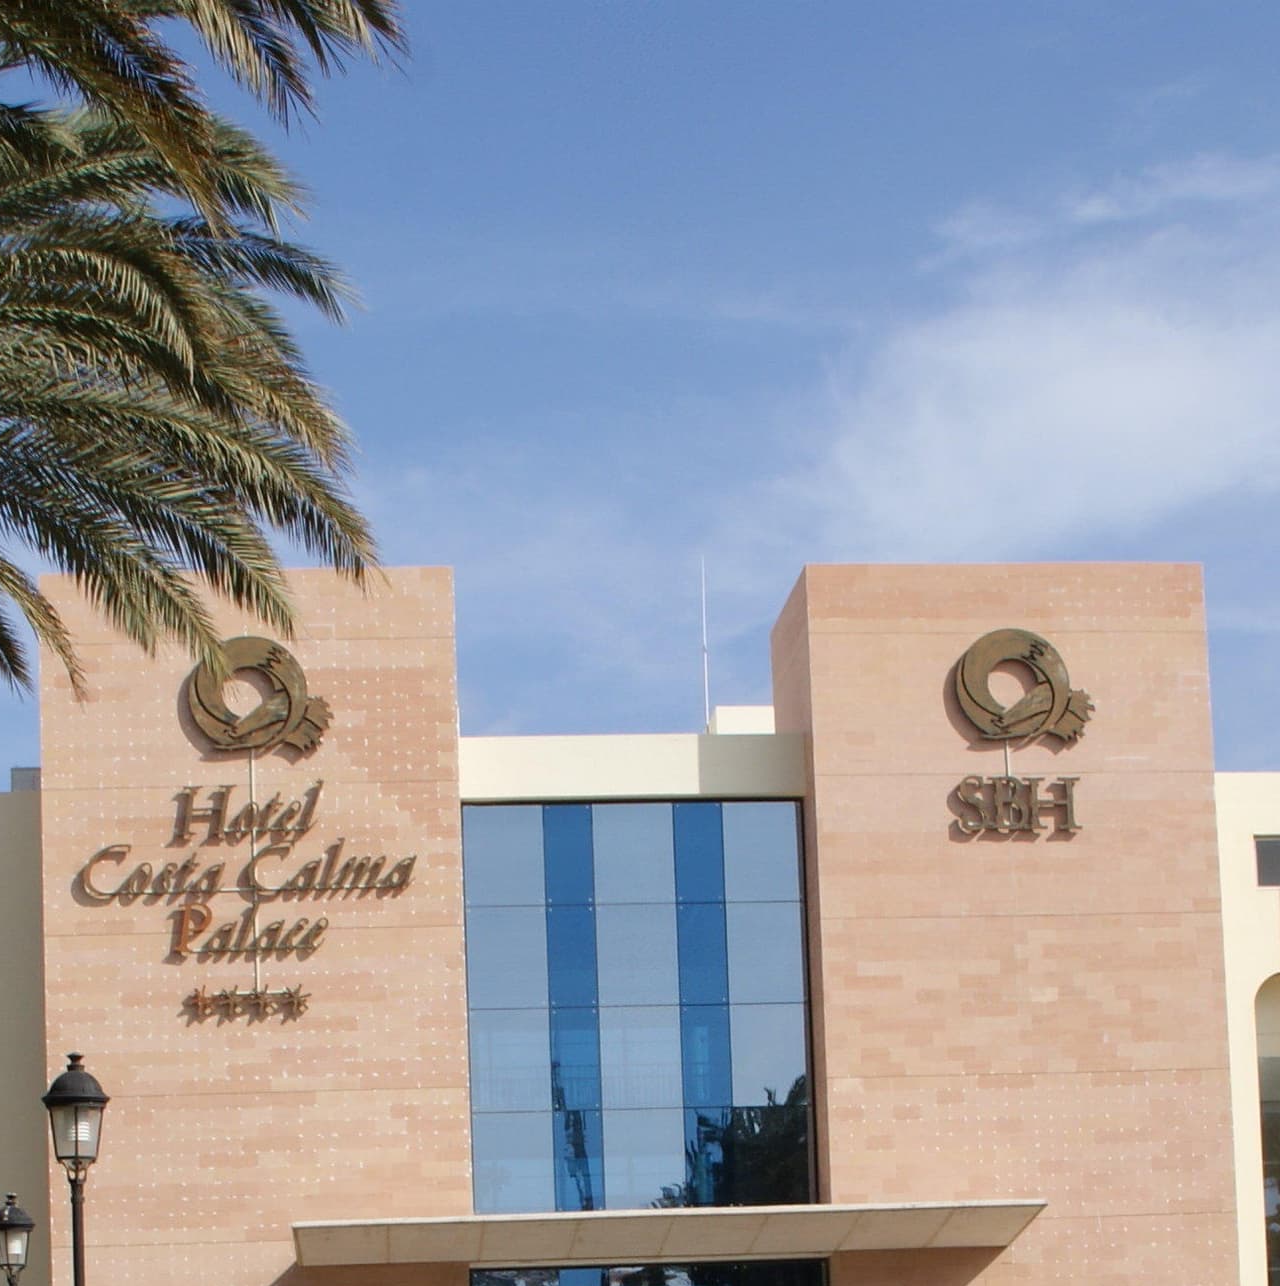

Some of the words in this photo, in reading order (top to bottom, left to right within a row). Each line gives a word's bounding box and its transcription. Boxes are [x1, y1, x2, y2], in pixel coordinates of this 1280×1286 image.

[172, 779, 325, 844] Hotel
[956, 775, 1083, 834] SBH
[81, 844, 226, 900] Costa
[246, 837, 418, 899] Calma
[171, 902, 330, 957] Palace
